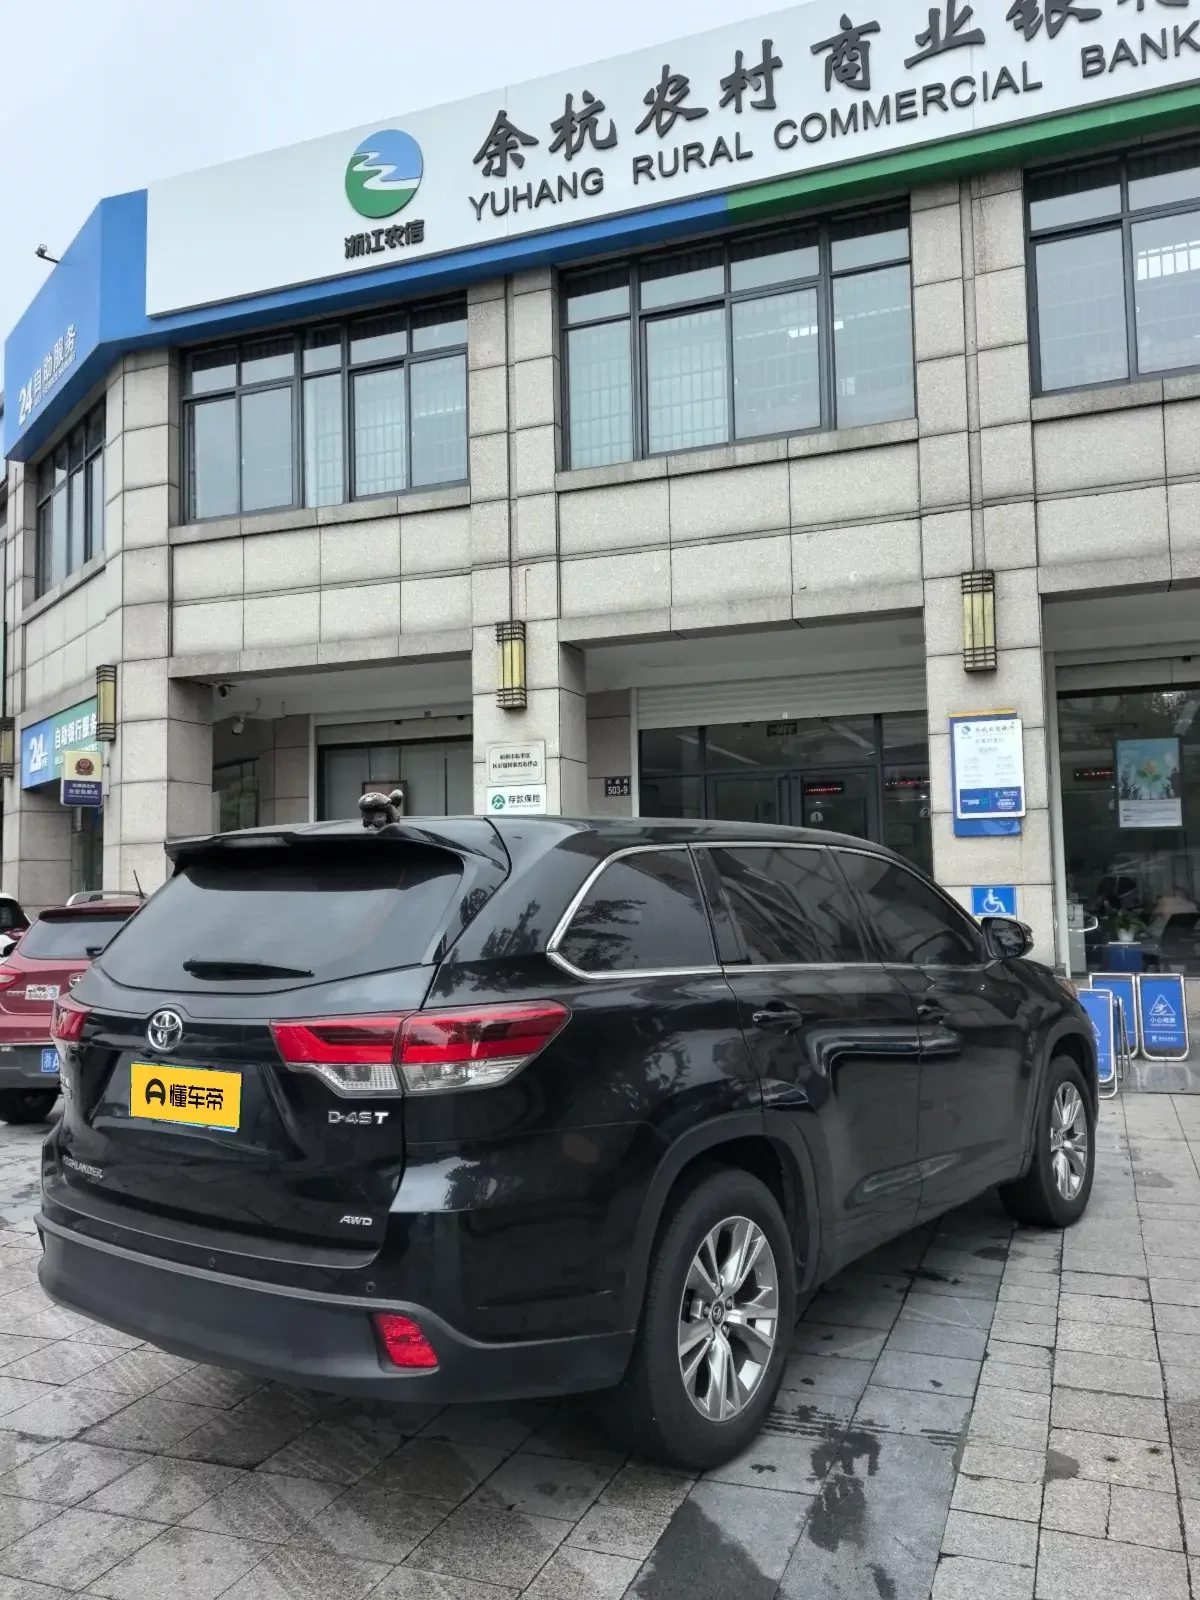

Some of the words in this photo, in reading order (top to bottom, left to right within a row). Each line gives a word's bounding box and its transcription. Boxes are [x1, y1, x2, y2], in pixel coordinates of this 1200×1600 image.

[473, 0, 1190, 177] 余杭农村商业银
[468, 168, 605, 221] YUHANG
[632, 131, 754, 185] RURAL
[773, 60, 1044, 150] COMMERCIAL
[1080, 20, 1200, 78] BANK
[344, 219, 425, 260] 浙江农信
[18, 376, 33, 427] 24
[29, 733, 48, 773] 24
[508, 794, 541, 804] 存款保险
[608, 785, 628, 795] 503-9
[340, 1215, 373, 1226] AWD
